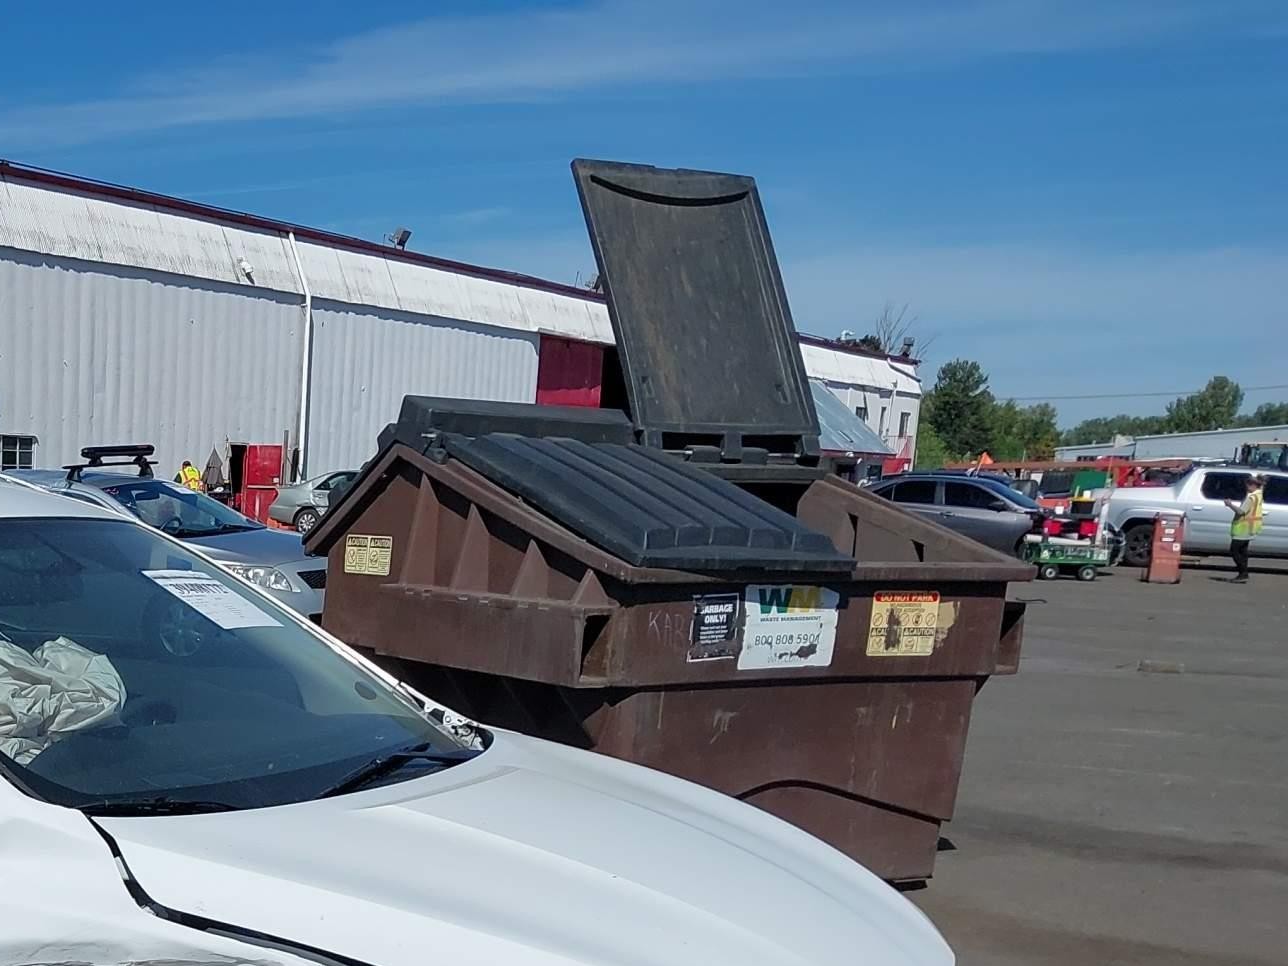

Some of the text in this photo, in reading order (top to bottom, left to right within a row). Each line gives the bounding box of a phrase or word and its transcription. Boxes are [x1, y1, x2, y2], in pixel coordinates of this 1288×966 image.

[758, 588, 823, 614] WM
[704, 614, 727, 624] ONLY!
[754, 634, 773, 646] 800
[775, 633, 794, 645] 808
